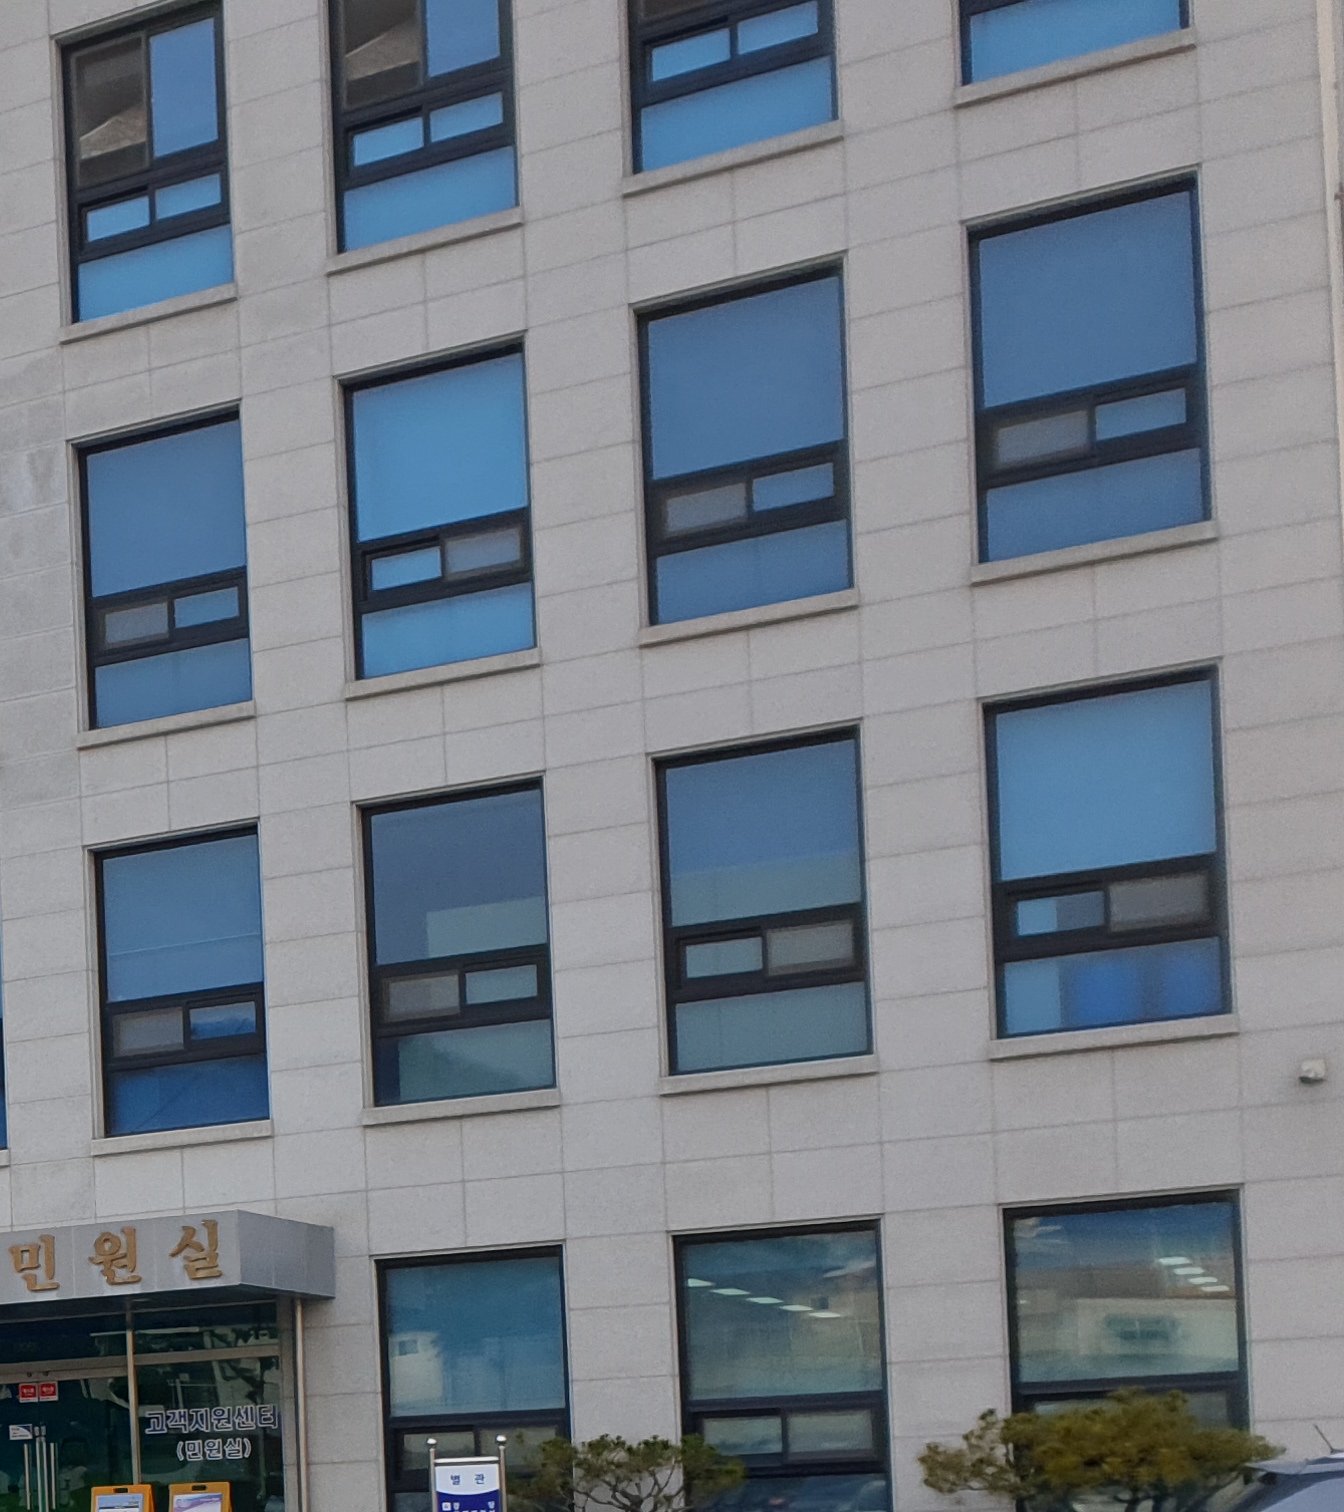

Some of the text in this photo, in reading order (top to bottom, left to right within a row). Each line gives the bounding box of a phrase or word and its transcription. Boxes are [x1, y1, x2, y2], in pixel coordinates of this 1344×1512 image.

[8, 1219, 223, 1292] 민원실
[145, 1404, 278, 1434] 고객지원센터
[176, 1437, 252, 1462] (민원실)
